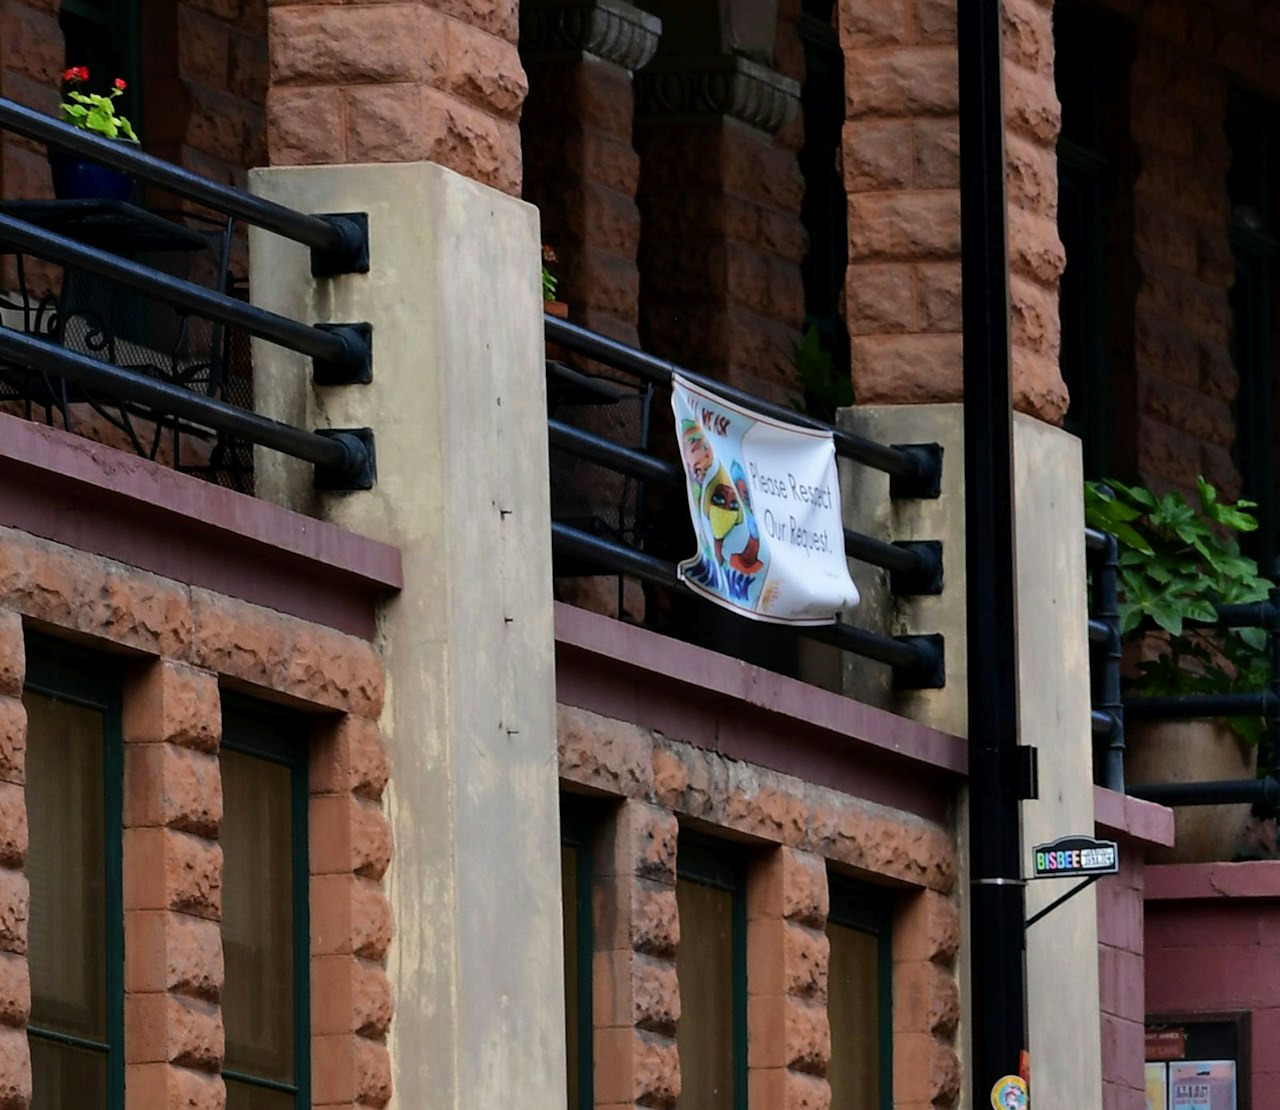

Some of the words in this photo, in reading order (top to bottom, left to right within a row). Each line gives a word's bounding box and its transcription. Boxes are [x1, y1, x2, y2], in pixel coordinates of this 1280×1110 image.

[750, 462, 787, 499] Please
[788, 473, 832, 509] Respect
[764, 508, 787, 538] Our
[790, 515, 833, 558] Request.
[1036, 850, 1080, 870] BISBEE
